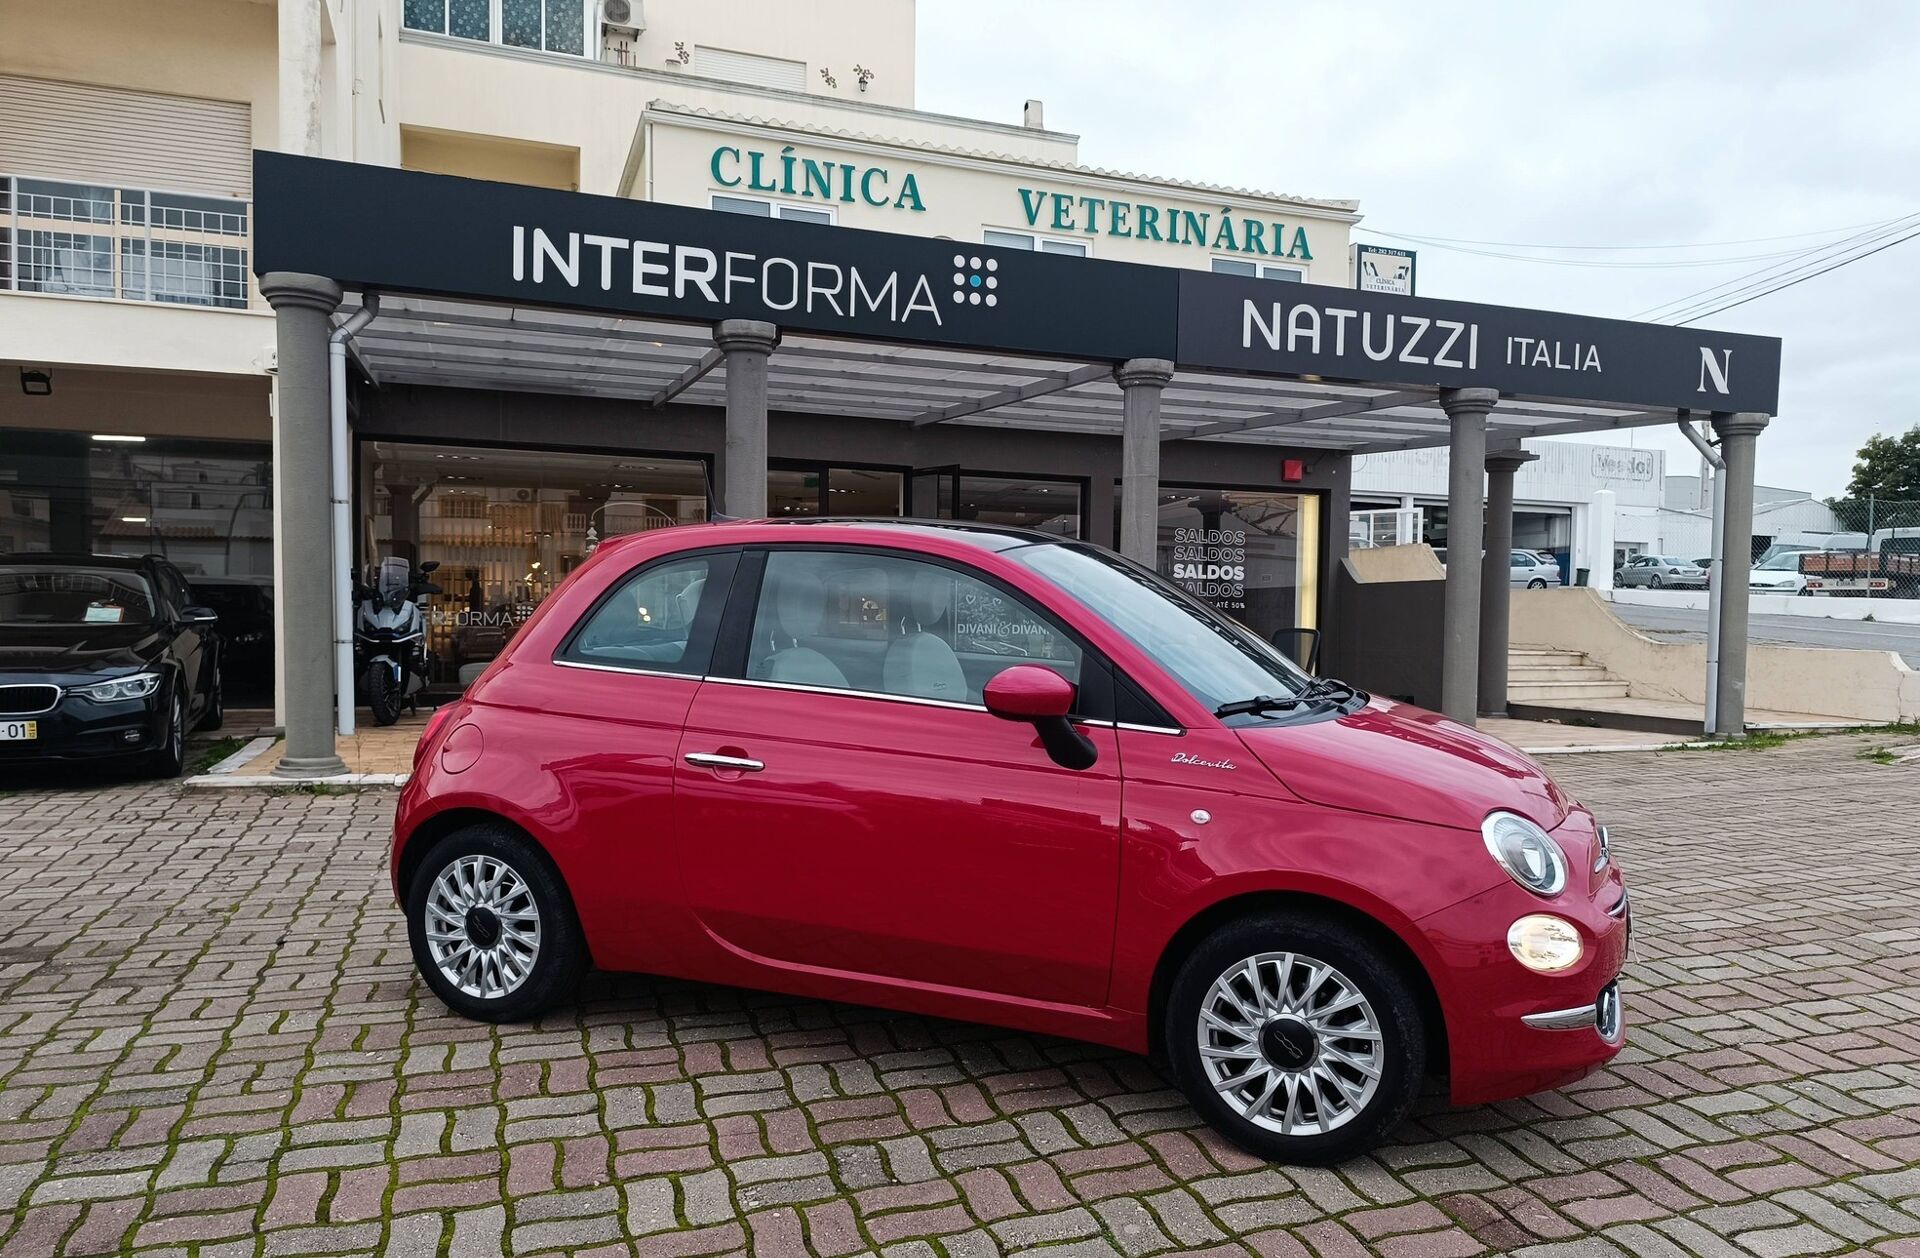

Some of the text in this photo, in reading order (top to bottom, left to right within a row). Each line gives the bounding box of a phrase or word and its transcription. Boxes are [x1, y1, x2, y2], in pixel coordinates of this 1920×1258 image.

[711, 146, 1314, 260] CLÍNICA VETERINÁRIA
[512, 225, 943, 326] INTERFORMA
[1243, 299, 1602, 373] NATUZZI ITALIA
[1697, 346, 1733, 394] N
[1174, 527, 1246, 546] SALDOS
[1173, 545, 1245, 563] SALDOS
[1173, 563, 1245, 581] SALDOS
[1215, 600, 1229, 609] ATÉ
[1231, 601, 1246, 609] 50%
[1171, 752, 1237, 770] Dolcevita
